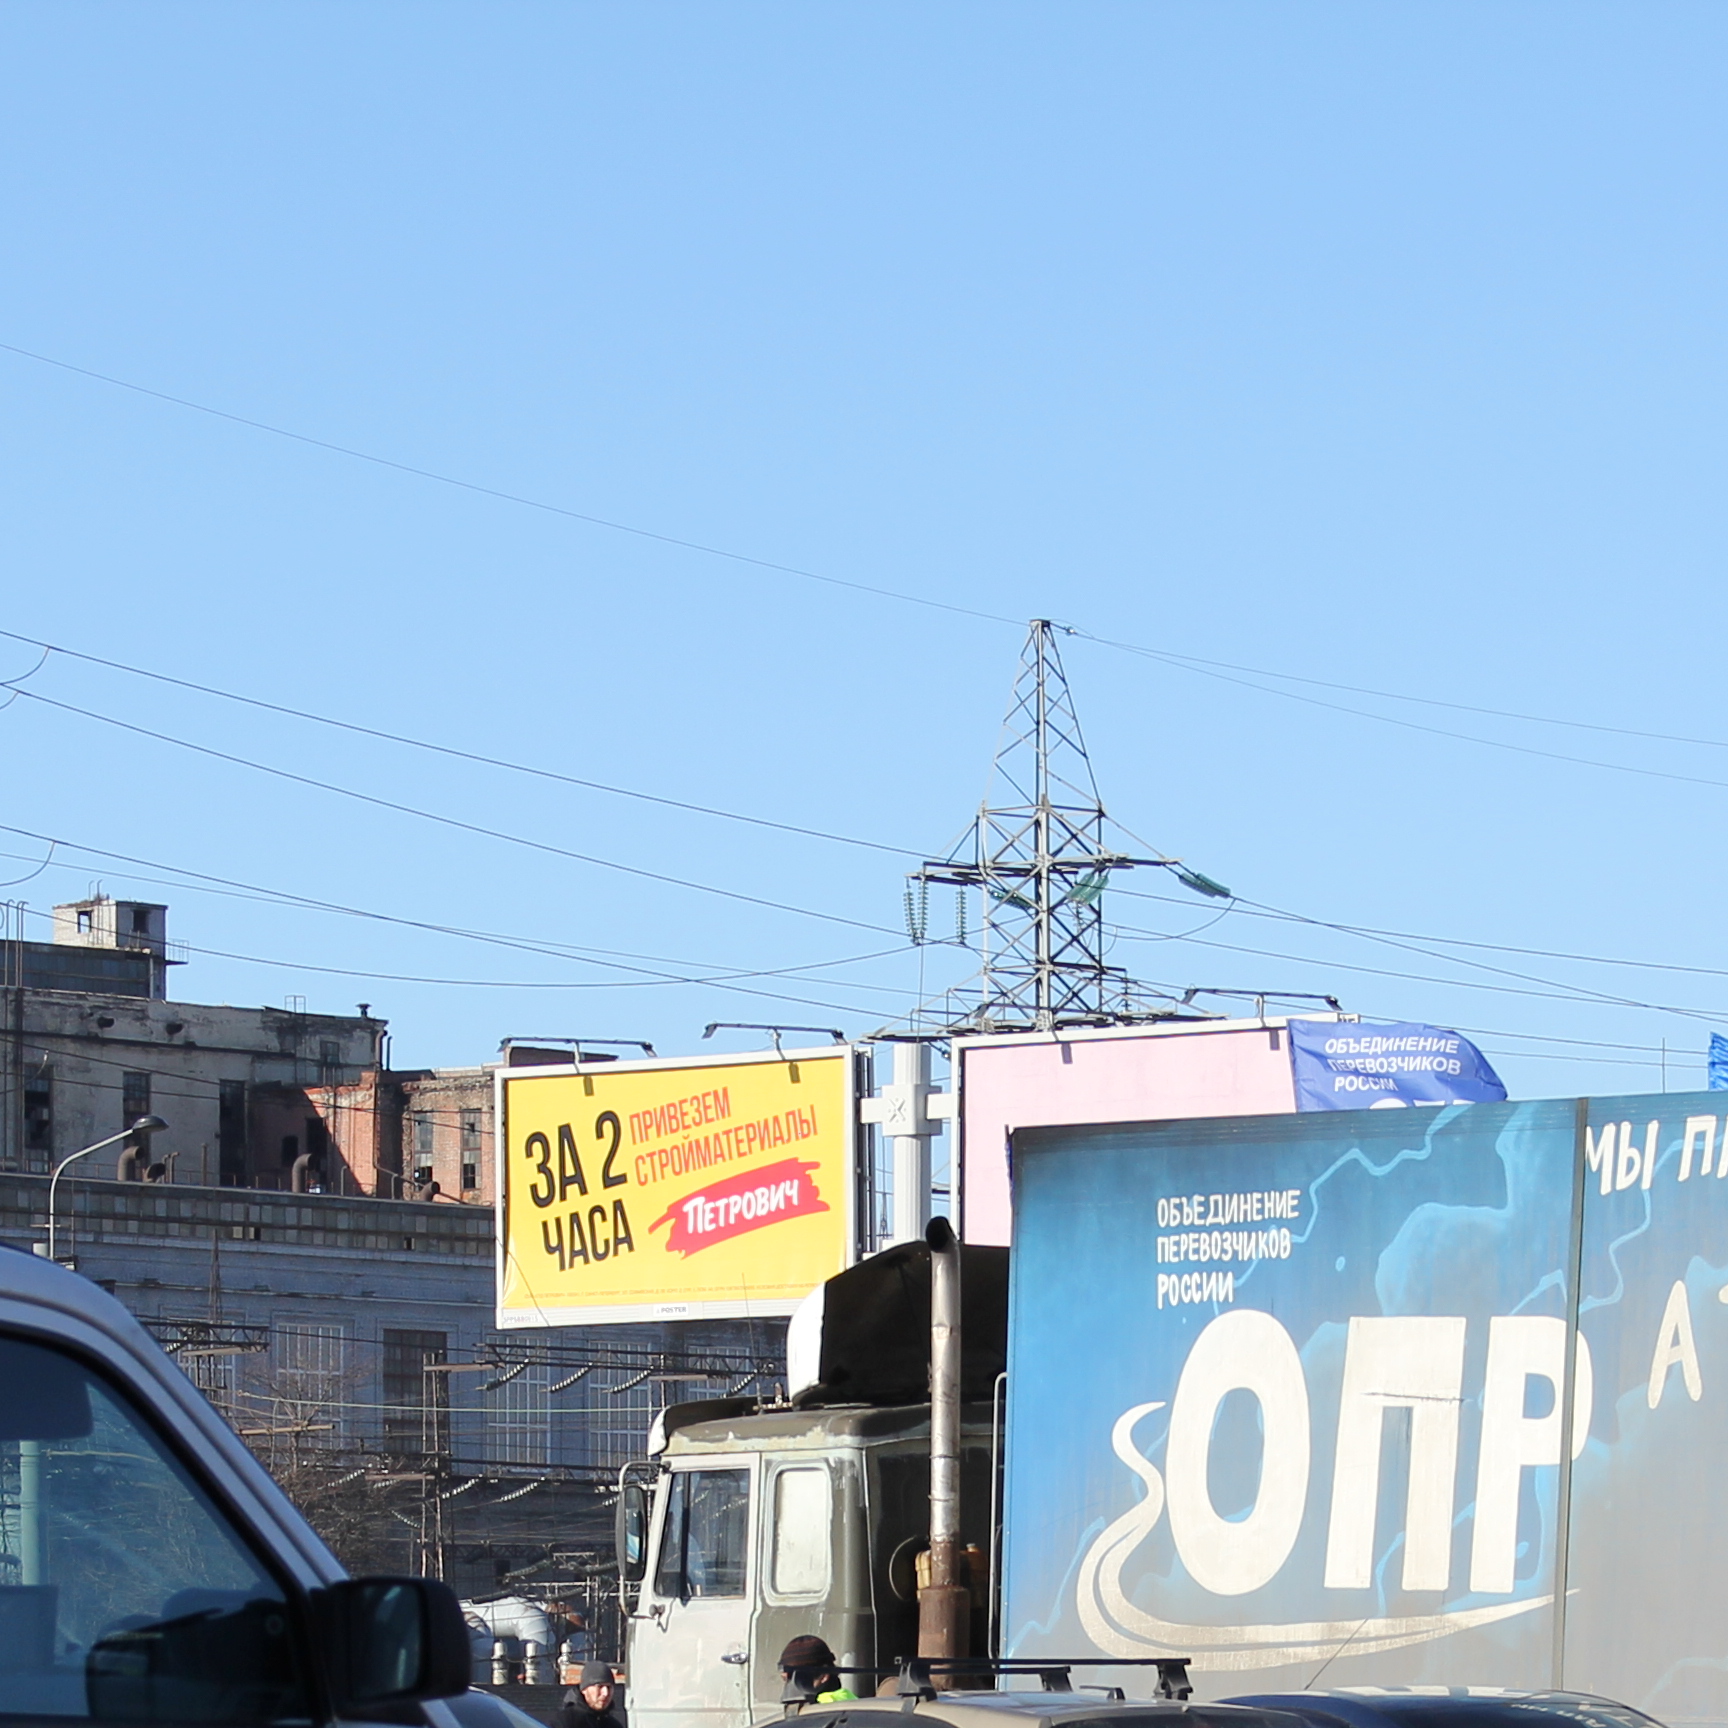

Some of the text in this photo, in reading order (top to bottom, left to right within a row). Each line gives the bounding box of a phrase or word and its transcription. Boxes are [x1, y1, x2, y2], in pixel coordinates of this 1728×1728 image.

[1325, 1037, 1460, 1055] ОБЪЕДИНЕНИЕ
[1327, 1057, 1461, 1075] ПЕРЕВОЗЧИКОВ
[1334, 1076, 1399, 1091] РОССИИ
[629, 1086, 732, 1145] ПРИВЕЗЕМ
[524, 1110, 628, 1208] ЗА 2
[634, 1104, 819, 1187] СТРОЙМАТЕРИАЛЫ
[1585, 1119, 1659, 1196] МЫ
[541, 1198, 635, 1272] ЧАСА
[1157, 1190, 1300, 1229] ОБЪЕДИНЕНИЕ
[1157, 1228, 1291, 1264] ПЕРЕВОЗЧИКОВ
[1157, 1271, 1234, 1309] РОССИИ
[1647, 1280, 1702, 1409] А
[1164, 1309, 1593, 1596] ОПР
